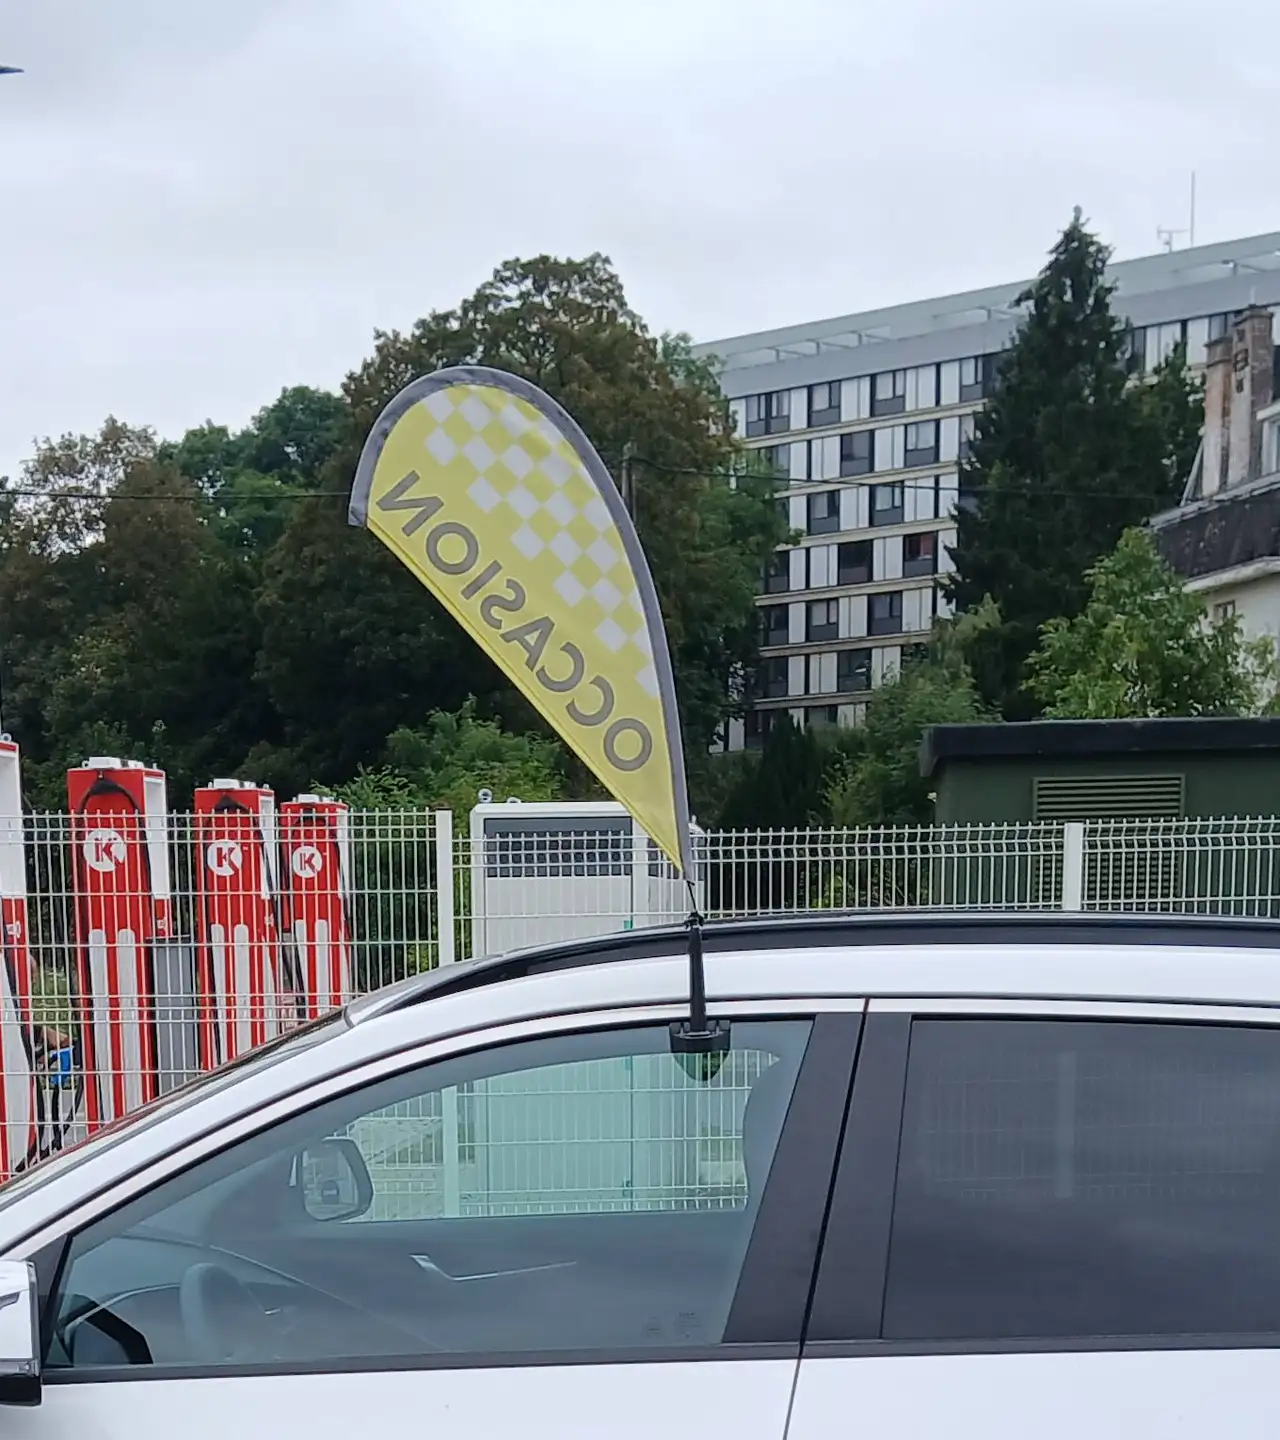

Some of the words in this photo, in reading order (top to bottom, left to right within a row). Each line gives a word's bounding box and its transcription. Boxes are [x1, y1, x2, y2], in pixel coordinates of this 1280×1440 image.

[91, 834, 125, 870] K
[213, 844, 241, 875] K
[297, 850, 320, 876] K
